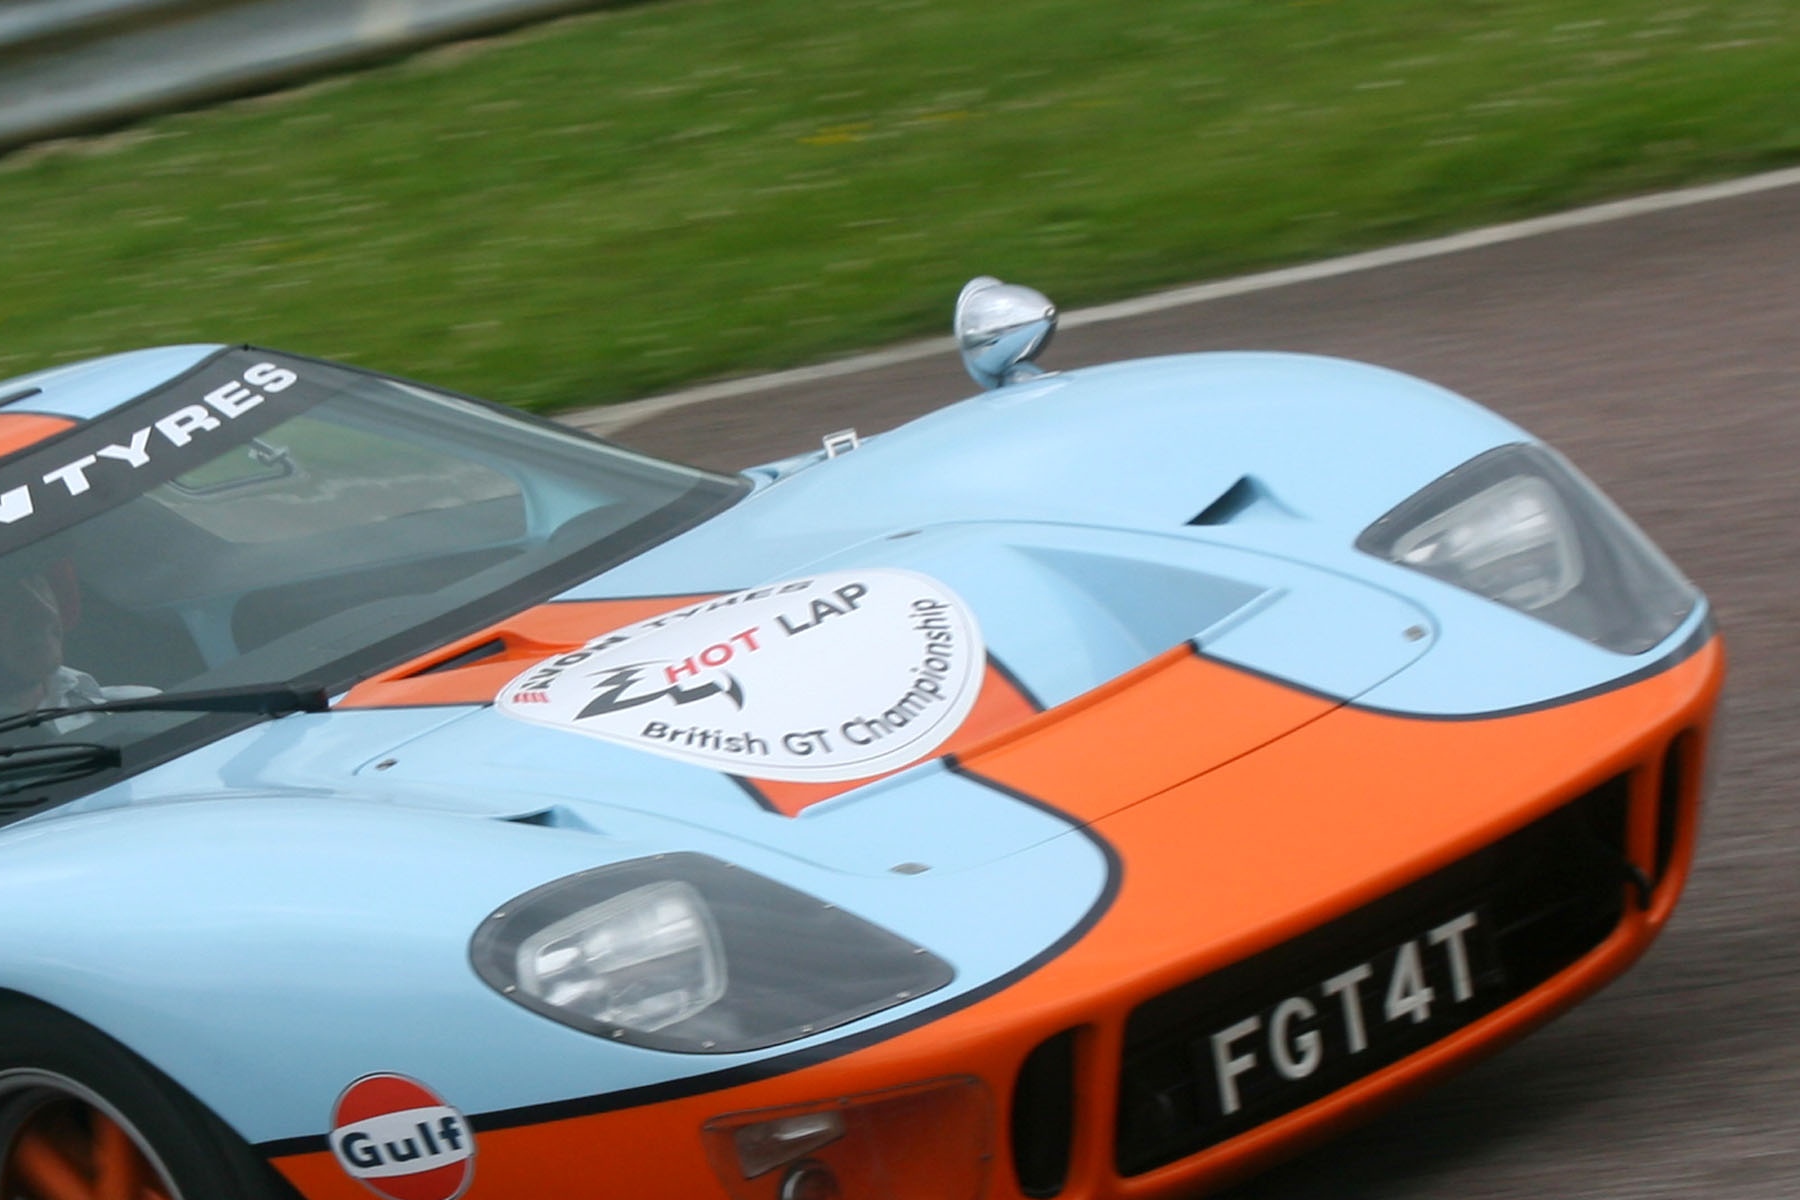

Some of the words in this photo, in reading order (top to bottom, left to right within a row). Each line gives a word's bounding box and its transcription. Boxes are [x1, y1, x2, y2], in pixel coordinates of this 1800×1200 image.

[42, 361, 298, 497] TYRES
[640, 720, 770, 757] British
[781, 729, 834, 757] GT
[840, 597, 954, 747] Championship
[663, 626, 761, 684] HOT
[773, 582, 870, 638] LAP
[340, 1116, 465, 1170] Gulf
